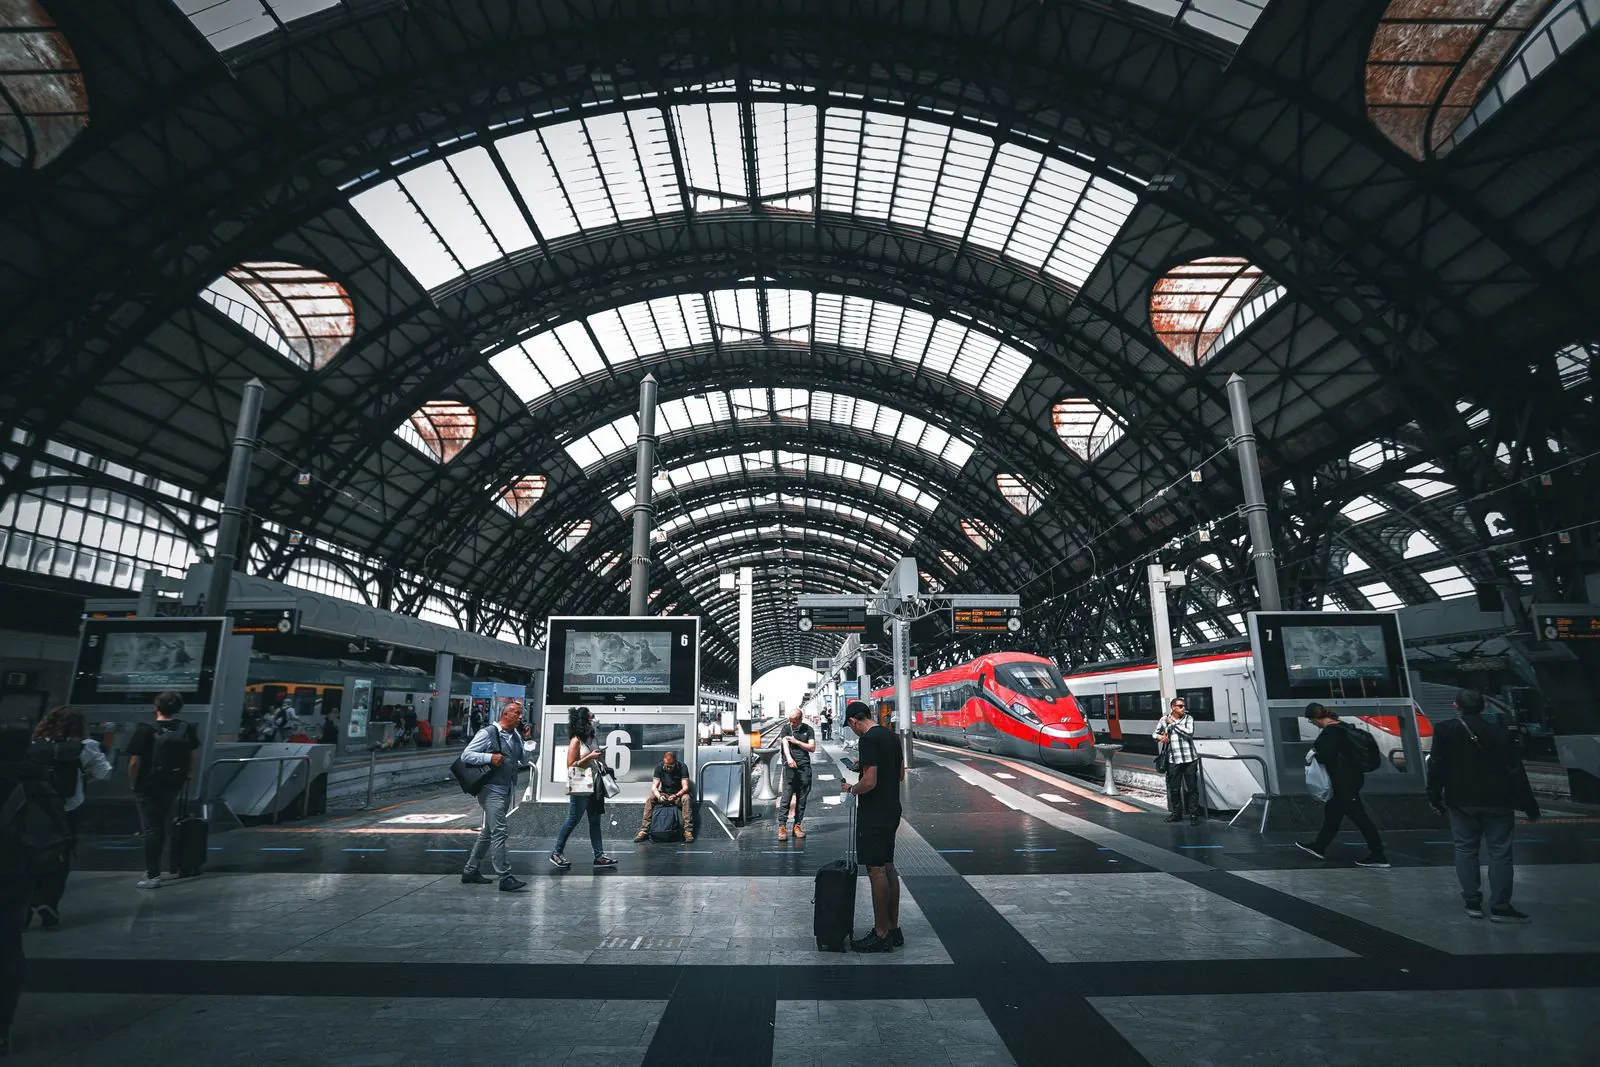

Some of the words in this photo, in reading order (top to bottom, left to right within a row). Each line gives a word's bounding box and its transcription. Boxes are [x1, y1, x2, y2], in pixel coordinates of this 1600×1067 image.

[680, 634, 689, 647] 6
[1265, 629, 1273, 642] 7
[605, 729, 632, 777] 6
